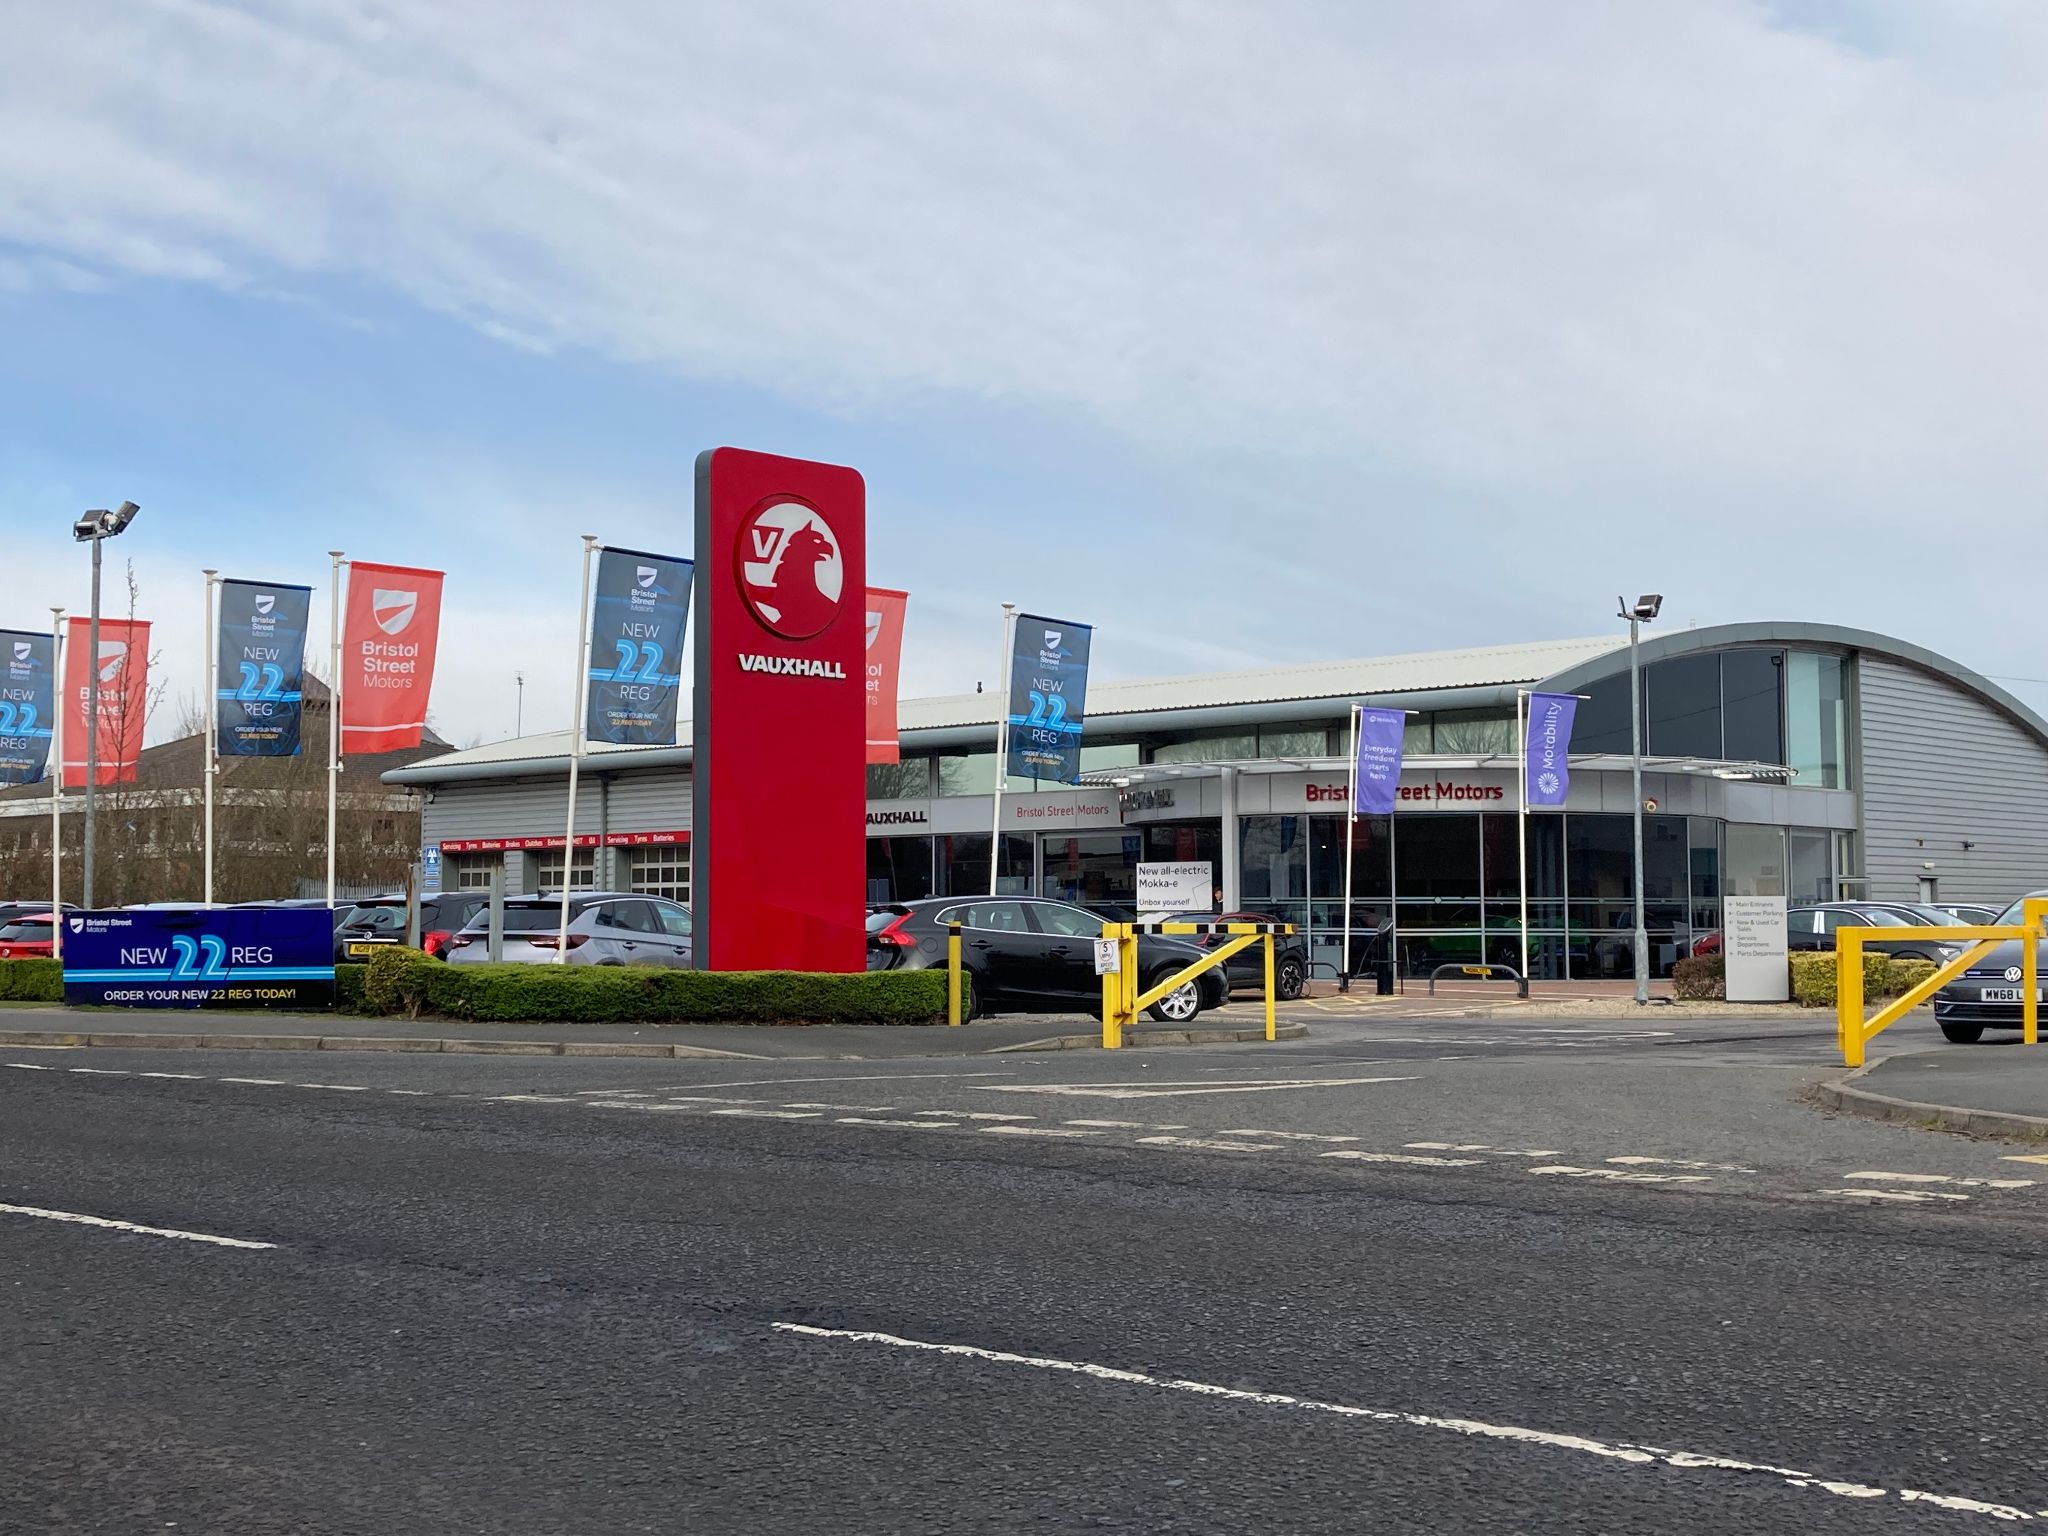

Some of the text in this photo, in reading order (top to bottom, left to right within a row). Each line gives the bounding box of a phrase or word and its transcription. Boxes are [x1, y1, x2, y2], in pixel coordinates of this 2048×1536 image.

[631, 588, 657, 598] Bristol
[631, 596, 655, 606] Street
[251, 616, 276, 624] Bristol
[252, 623, 274, 631] Street
[622, 622, 660, 639] NEW
[244, 646, 280, 660] NEW
[362, 641, 419, 657] Bristol
[1040, 649, 1061, 659] Bristol
[10, 661, 32, 669] Bristol
[363, 657, 415, 673] Street
[613, 639, 664, 684] 22
[739, 653, 846, 679] VAUXHALL
[1040, 657, 1059, 665] Street
[237, 661, 284, 701] 22
[364, 674, 412, 688] Motors
[1032, 678, 1064, 693] NEW
[3, 688, 35, 701] NEW
[620, 685, 650, 700] REG
[244, 703, 272, 716] REG
[1025, 691, 1067, 732] 22
[0, 701, 37, 736] 22
[1032, 728, 1057, 744] REG
[1543, 702, 1562, 769] Motability
[0, 738, 27, 750] REG
[1364, 745, 1397, 755] Everyday
[1364, 754, 1395, 763] freedom
[1368, 763, 1389, 772] starts
[1369, 772, 1386, 780] here
[1305, 782, 1504, 801] Brist reet Motors
[1016, 804, 1109, 818] Bristol Street Motors
[866, 811, 928, 825] AUXHALL
[1139, 865, 1209, 876] New all-electric
[1139, 879, 1178, 888] Mokka-e
[1162, 898, 1190, 907] yourself
[86, 918, 132, 926] Bristol Street
[1103, 942, 1109, 952] 5
[121, 934, 273, 981] NEW 22 REG
[104, 989, 296, 1000] ORDER YOUR NEW 22 REG TODAY!
[1986, 989, 2014, 1000] MW68
